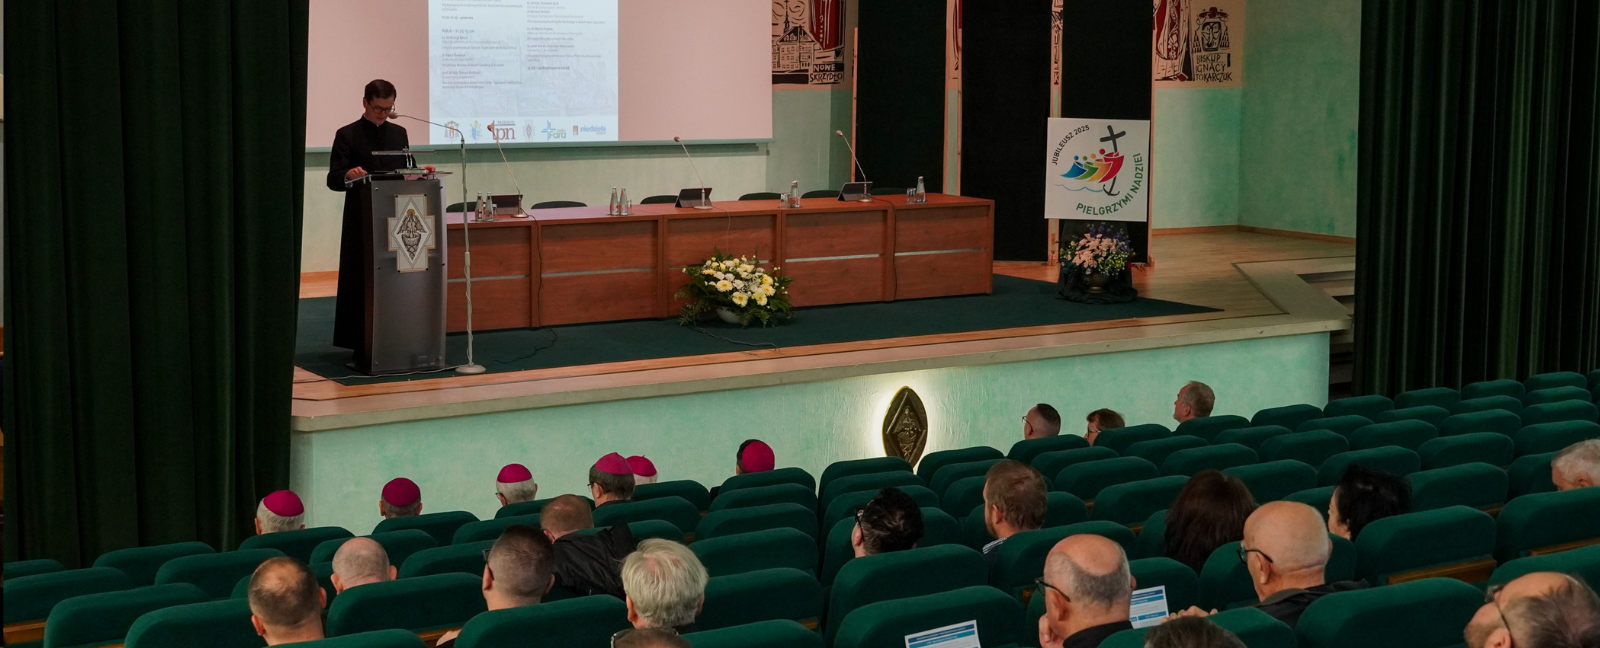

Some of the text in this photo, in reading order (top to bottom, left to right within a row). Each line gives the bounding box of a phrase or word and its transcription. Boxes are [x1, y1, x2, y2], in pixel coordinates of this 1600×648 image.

[1197, 54, 1221, 64] BISKUP
[1196, 63, 1226, 73] IGNACY
[810, 72, 843, 82] SKRZYDŁO
[1196, 72, 1232, 83] TOKARCZUK
[1052, 124, 1090, 166] JUBILEUSZ 2025
[1076, 152, 1144, 216] PIELGRZYMI NADZIEI
